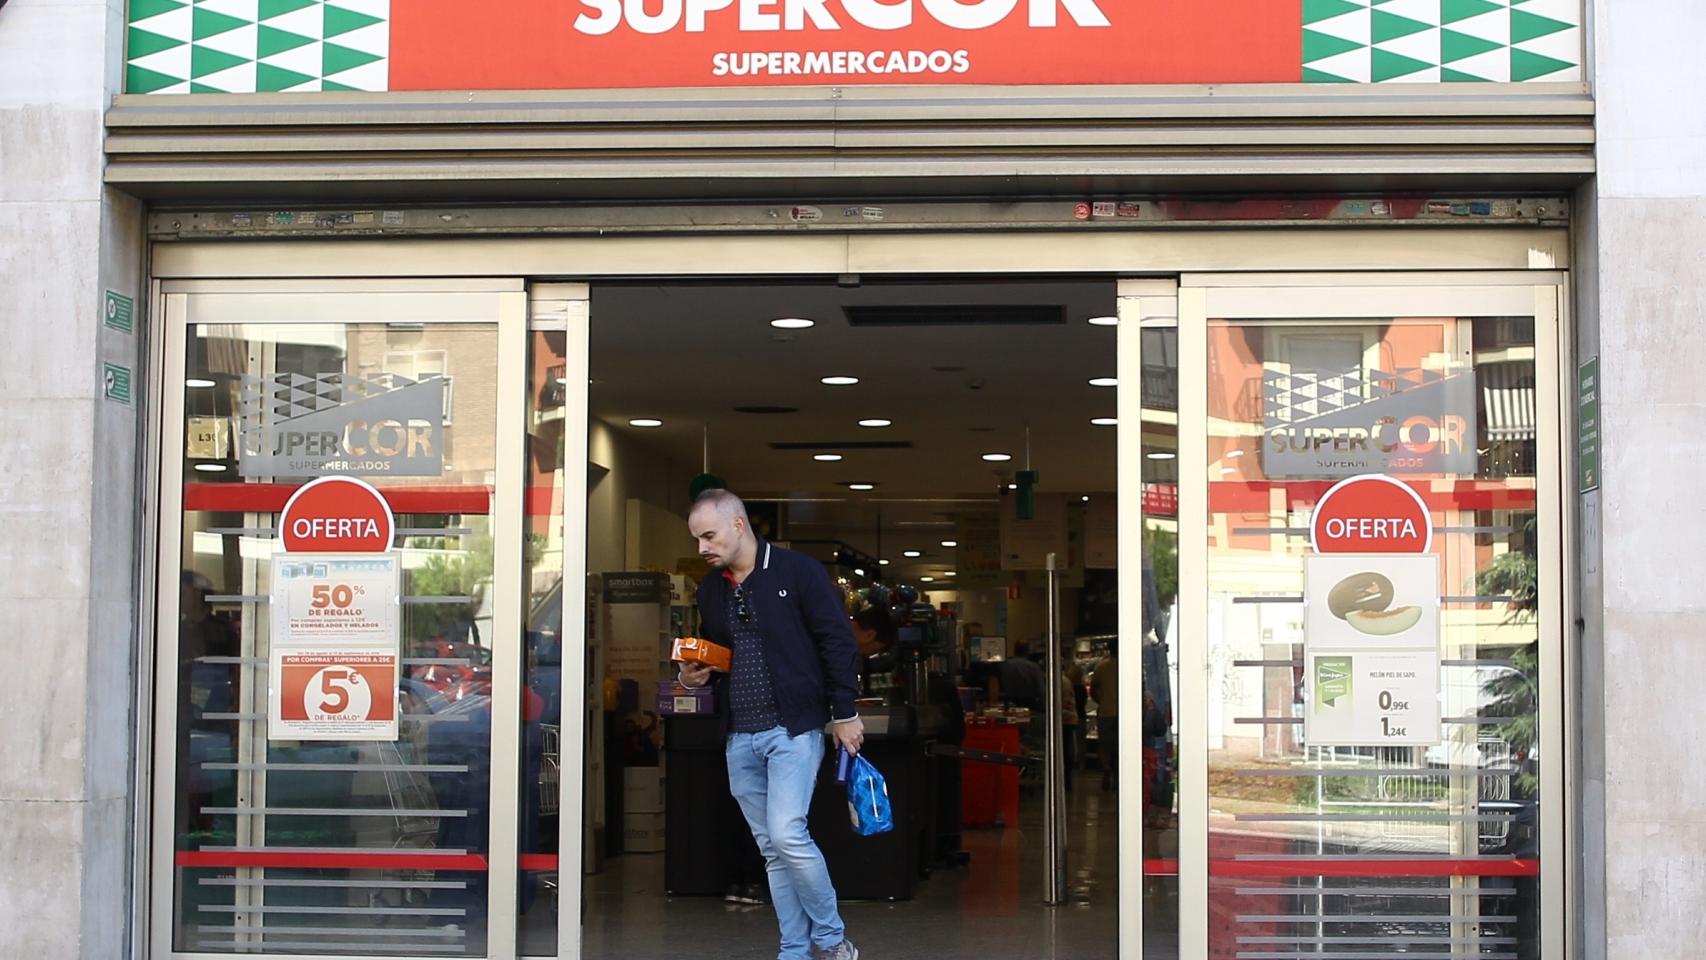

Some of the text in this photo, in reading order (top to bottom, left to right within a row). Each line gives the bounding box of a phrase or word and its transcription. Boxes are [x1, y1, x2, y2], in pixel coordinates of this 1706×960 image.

[712, 49, 970, 76] SUPERMERCADOS
[1270, 415, 1468, 454] SUPERCOR
[288, 461, 391, 471] SUPERMERCADOS
[293, 518, 380, 539] OFERTA
[1325, 518, 1417, 539] OFERTA
[608, 577, 654, 586] smartbox
[311, 584, 366, 609] 50%
[319, 670, 360, 714] 5€
[1378, 690, 1409, 711] 0,99€
[1380, 717, 1407, 737] 1,24€
